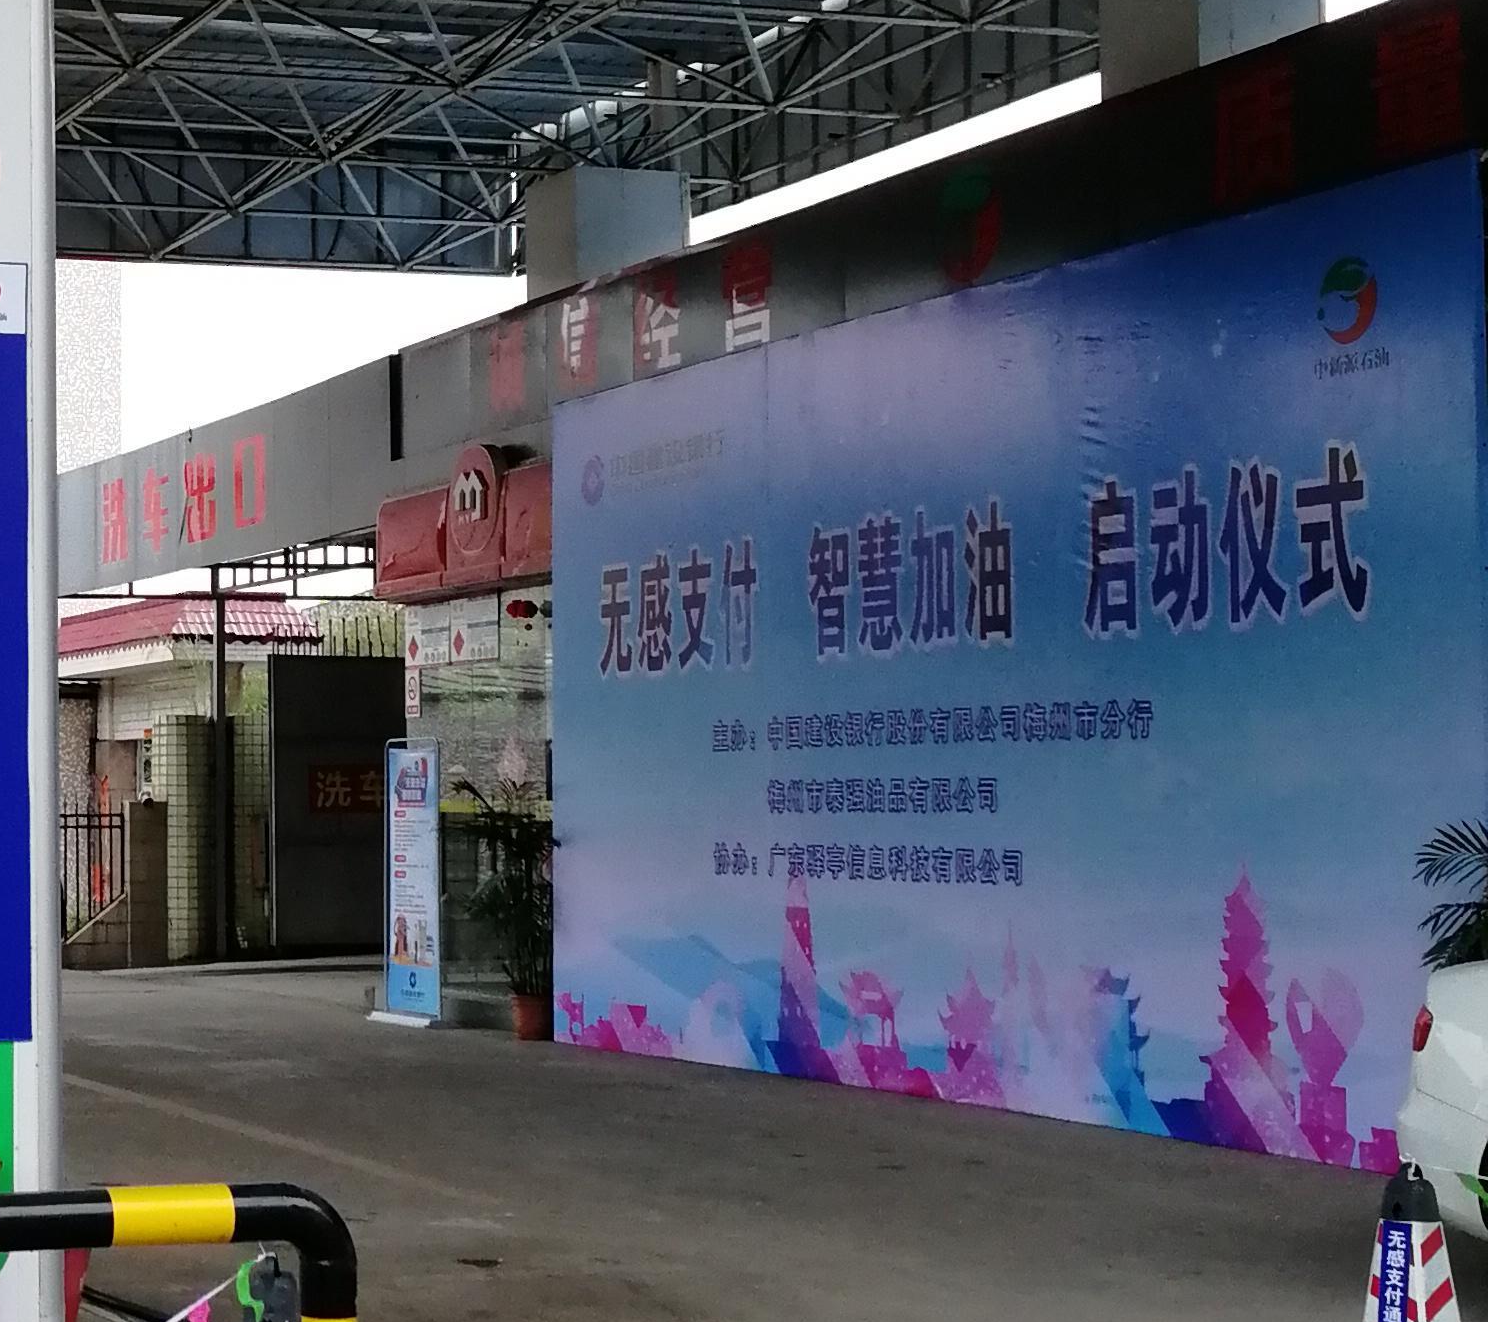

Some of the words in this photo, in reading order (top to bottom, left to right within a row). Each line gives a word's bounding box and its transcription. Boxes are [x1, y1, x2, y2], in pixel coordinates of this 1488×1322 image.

[101, 433, 267, 565] 洗车出口
[598, 536, 758, 678] 无感支付
[808, 498, 1012, 657] 智慧加油
[1083, 444, 1371, 635] 启动仪式
